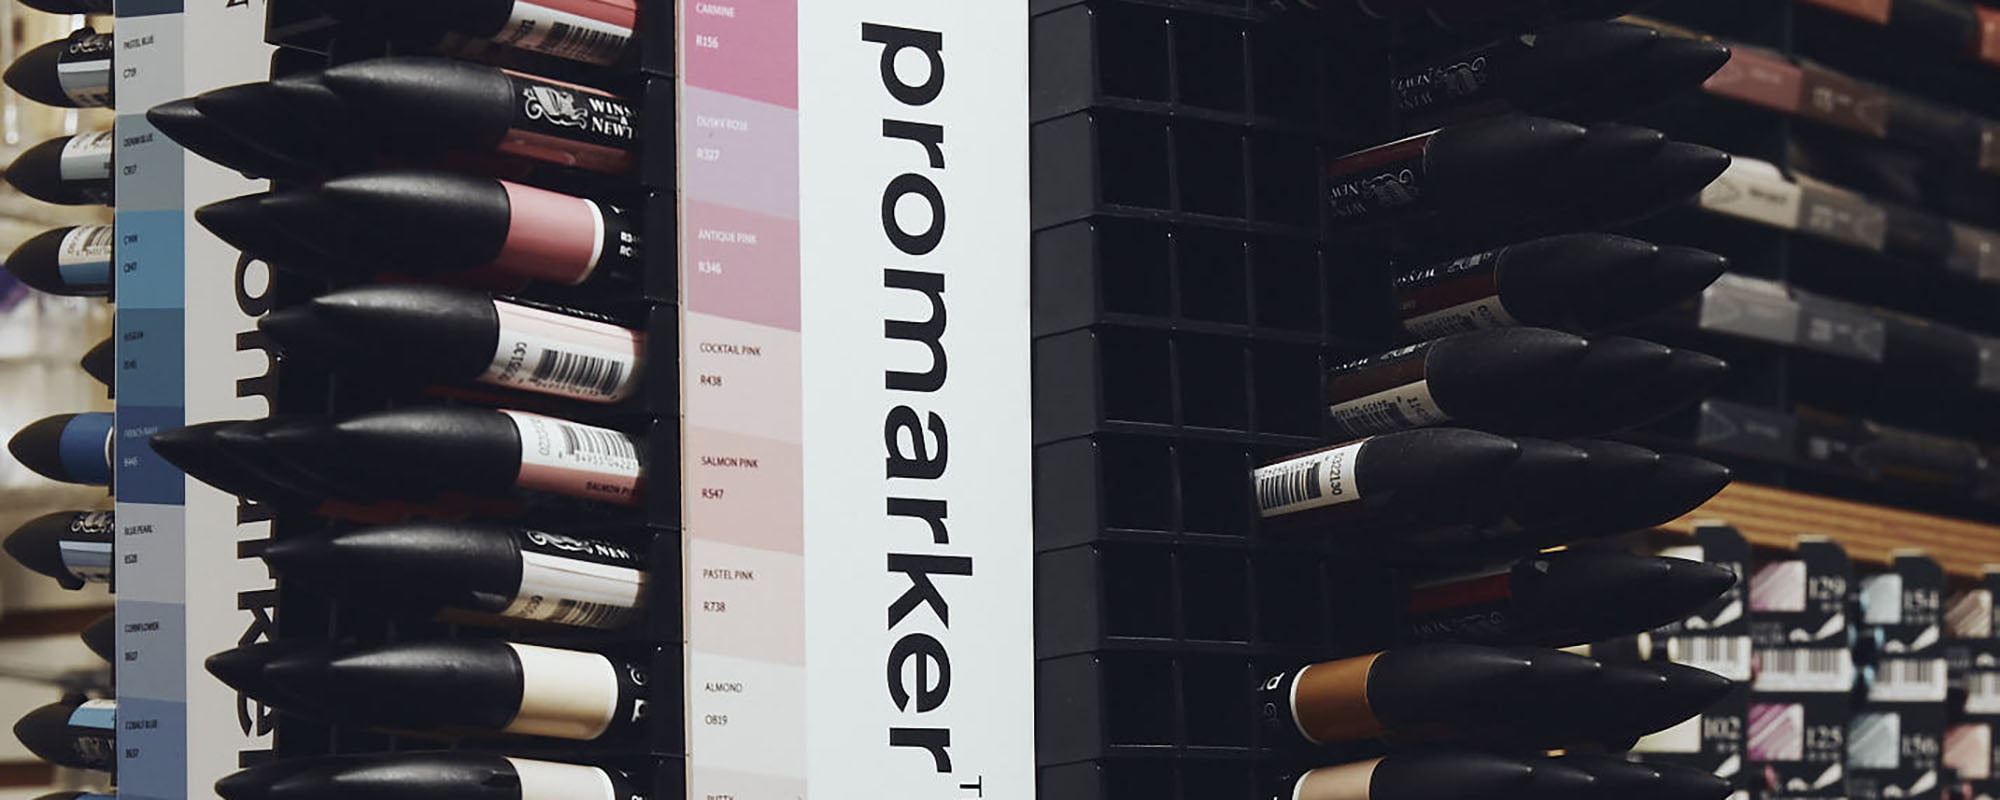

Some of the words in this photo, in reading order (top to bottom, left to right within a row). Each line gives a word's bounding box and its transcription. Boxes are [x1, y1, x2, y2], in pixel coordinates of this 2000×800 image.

[696, 3, 735, 18] CARMINE
[696, 34, 719, 49] R156
[698, 229, 735, 242] ANTIQUE
[737, 232, 756, 244] PINK
[698, 261, 722, 275] R346
[700, 343, 740, 355] COCKTAIL
[741, 346, 761, 356] PINK
[700, 375, 722, 387] R438
[861, 22, 973, 773] promarker
[701, 456, 738, 467] SALMON
[739, 458, 759, 468] PINK
[702, 489, 724, 500] R547
[703, 568, 733, 580] PASTEL
[734, 570, 754, 580] PINK
[1808, 576, 1846, 601] 129
[703, 601, 726, 612] R738
[704, 681, 743, 694] ALMOND
[1703, 716, 1740, 741] 102
[1806, 727, 1843, 750] 125
